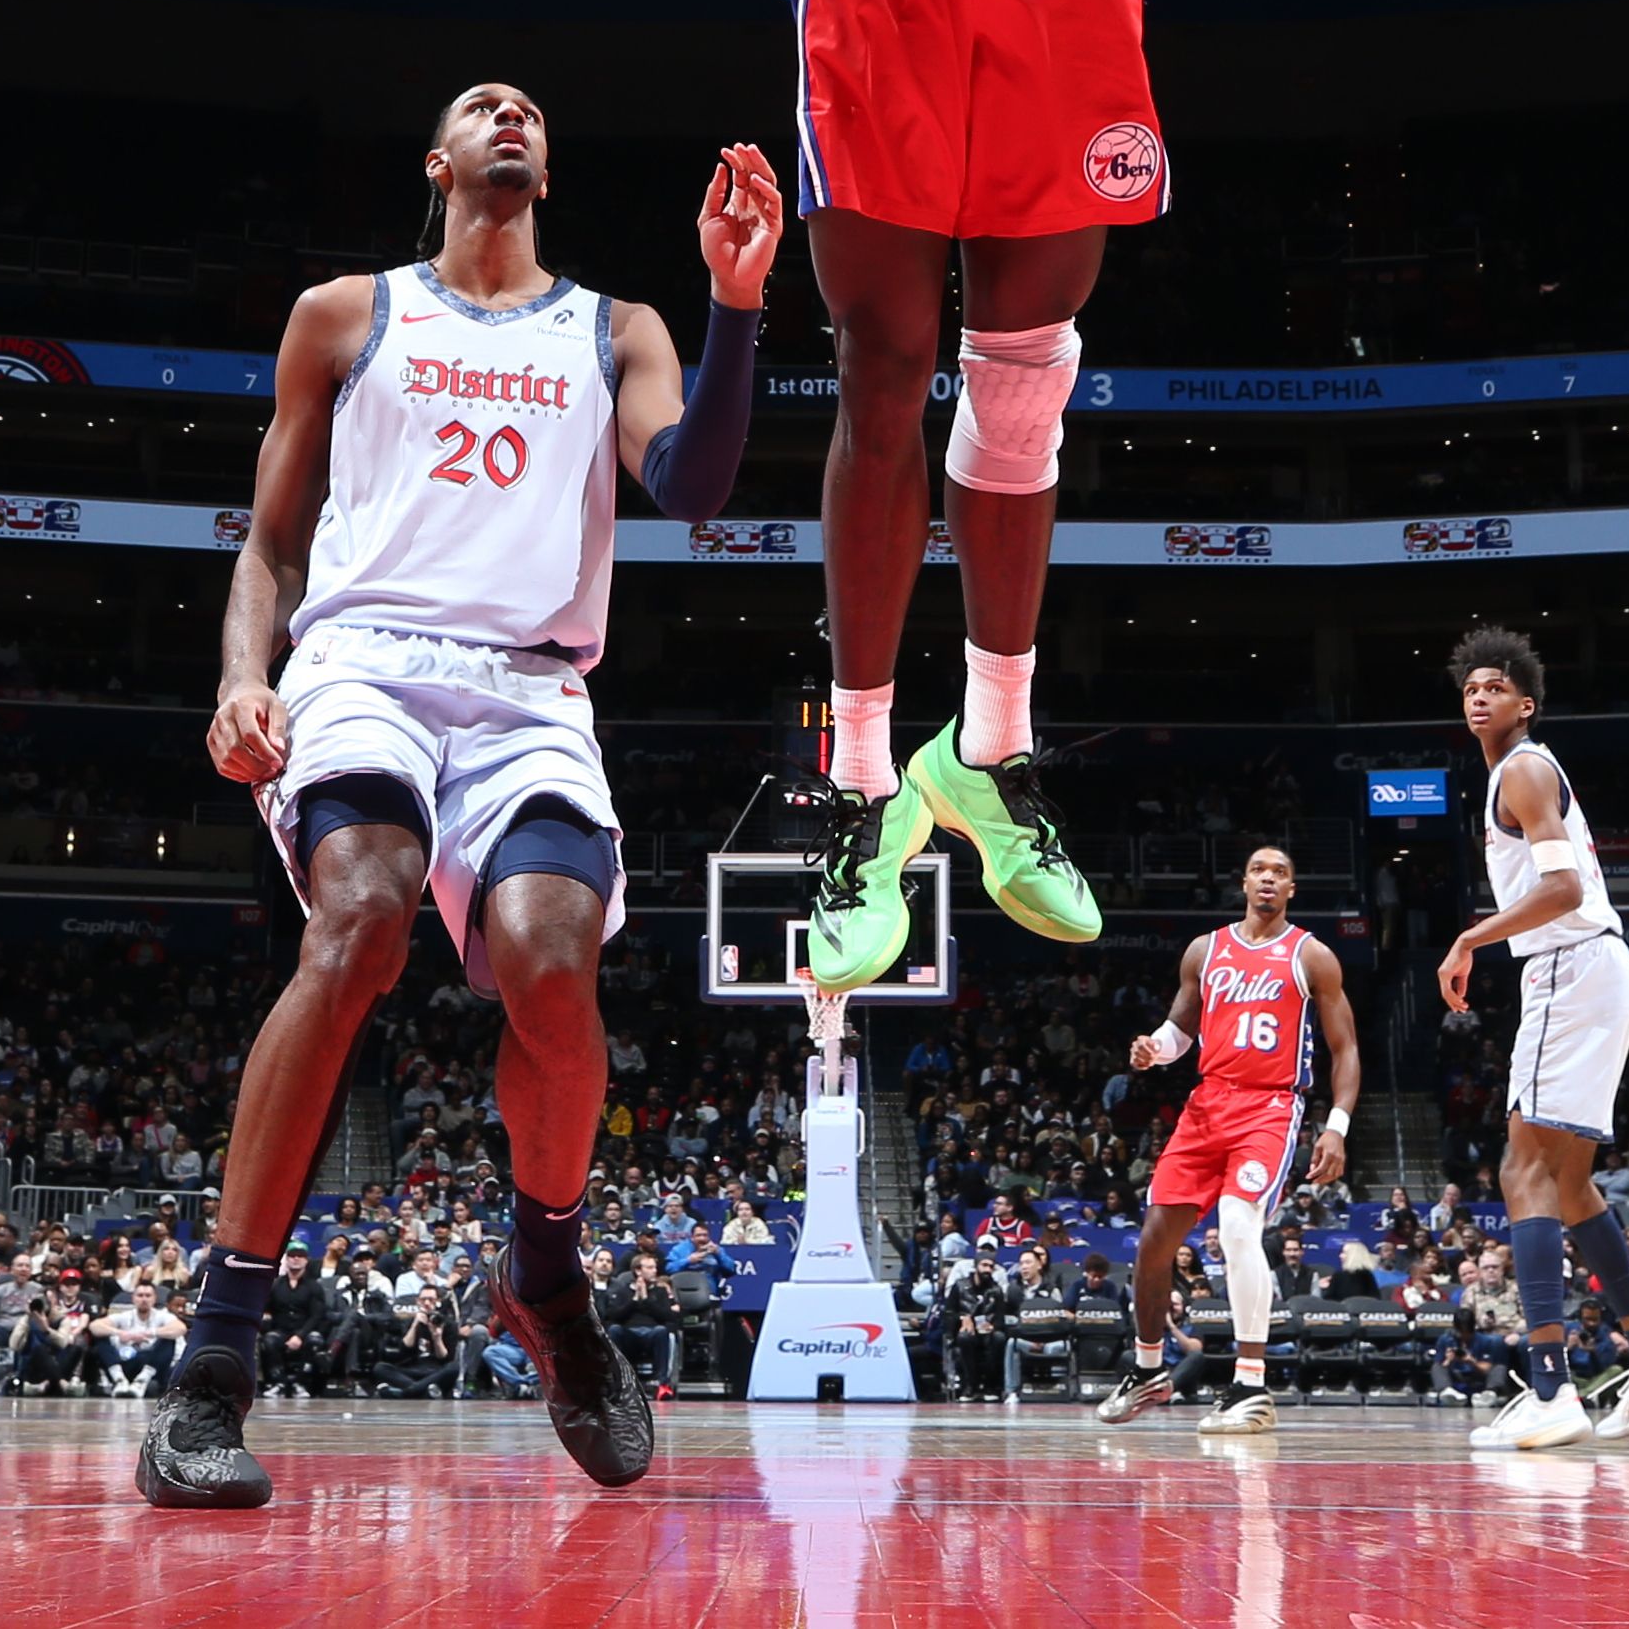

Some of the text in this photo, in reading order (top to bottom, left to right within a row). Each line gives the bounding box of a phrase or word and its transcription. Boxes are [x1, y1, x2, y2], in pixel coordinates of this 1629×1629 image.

[1093, 152, 1153, 181] 76ers
[536, 326, 589, 342] Robinhood
[161, 368, 258, 391] 0 7
[402, 355, 570, 410] District
[767, 377, 839, 396] 1st QTR
[1089, 373, 1115, 406] 3
[1482, 376, 1576, 398] 0 7
[1169, 378, 1383, 402] PHILADELPHIA
[410, 396, 563, 420] OF COLUMBIA
[428, 419, 531, 491] 20
[238, 909, 261, 921] 107
[1342, 923, 1365, 934] 105
[1207, 965, 1284, 1014] Phila
[1233, 1010, 1279, 1054] 16
[1020, 1309, 1070, 1321] CAESARS
[1075, 1309, 1123, 1321] CAESARS
[1189, 1308, 1234, 1319] CAESARS
[1303, 1311, 1351, 1322] CAESARS
[1359, 1311, 1408, 1322] CAESARS
[1415, 1311, 1455, 1322] CAESA
